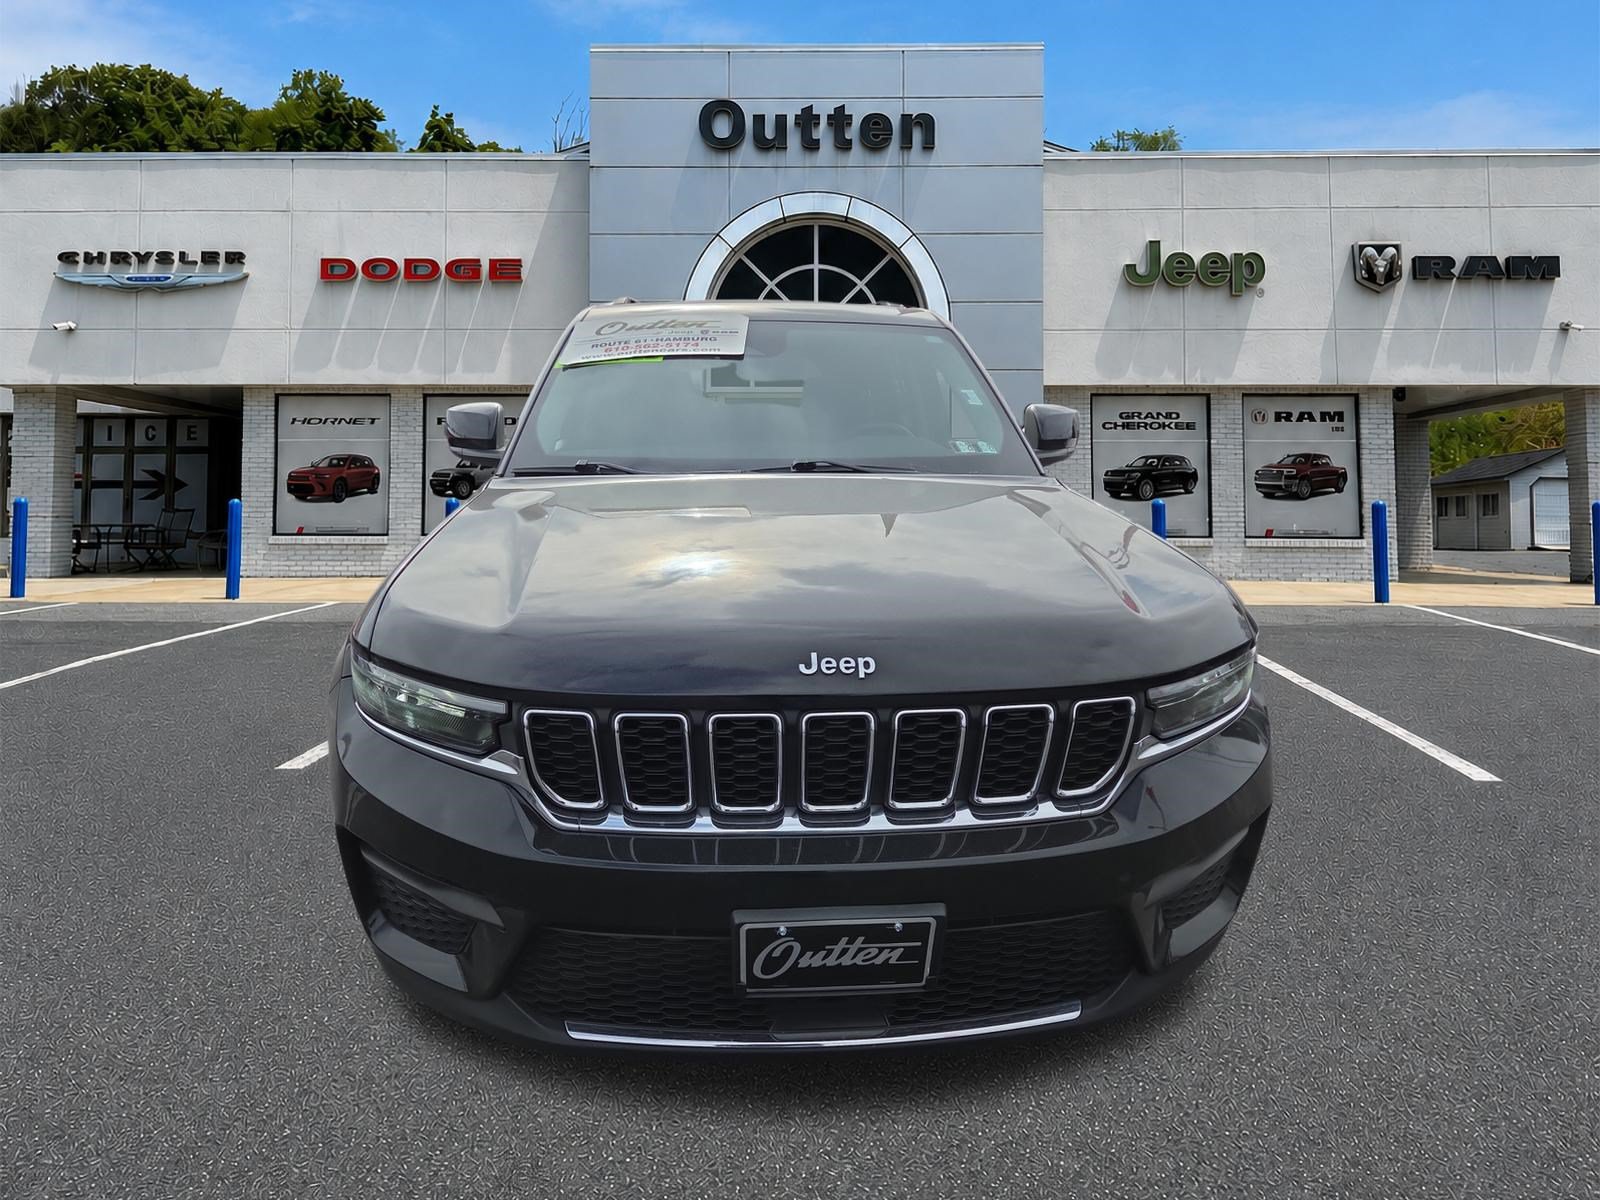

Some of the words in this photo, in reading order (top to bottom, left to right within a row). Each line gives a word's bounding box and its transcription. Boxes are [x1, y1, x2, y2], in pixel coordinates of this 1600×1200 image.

[699, 99, 936, 149] Outten
[57, 250, 247, 265] CHRYSLER
[320, 257, 523, 282] DODGE
[1124, 239, 1266, 296] Jeep
[1411, 255, 1560, 281] RAM
[595, 319, 721, 337] Outten
[591, 339, 632, 349] ROUTE
[655, 336, 718, 344] HAMBURG
[604, 342, 700, 353] 610-562-5174
[290, 415, 381, 426] HORNET
[1118, 411, 1180, 421] GRAND
[1274, 411, 1345, 423] RAM
[1101, 421, 1197, 431] CHEROKEE
[798, 651, 877, 678] Jeep
[752, 935, 922, 980] Outten
